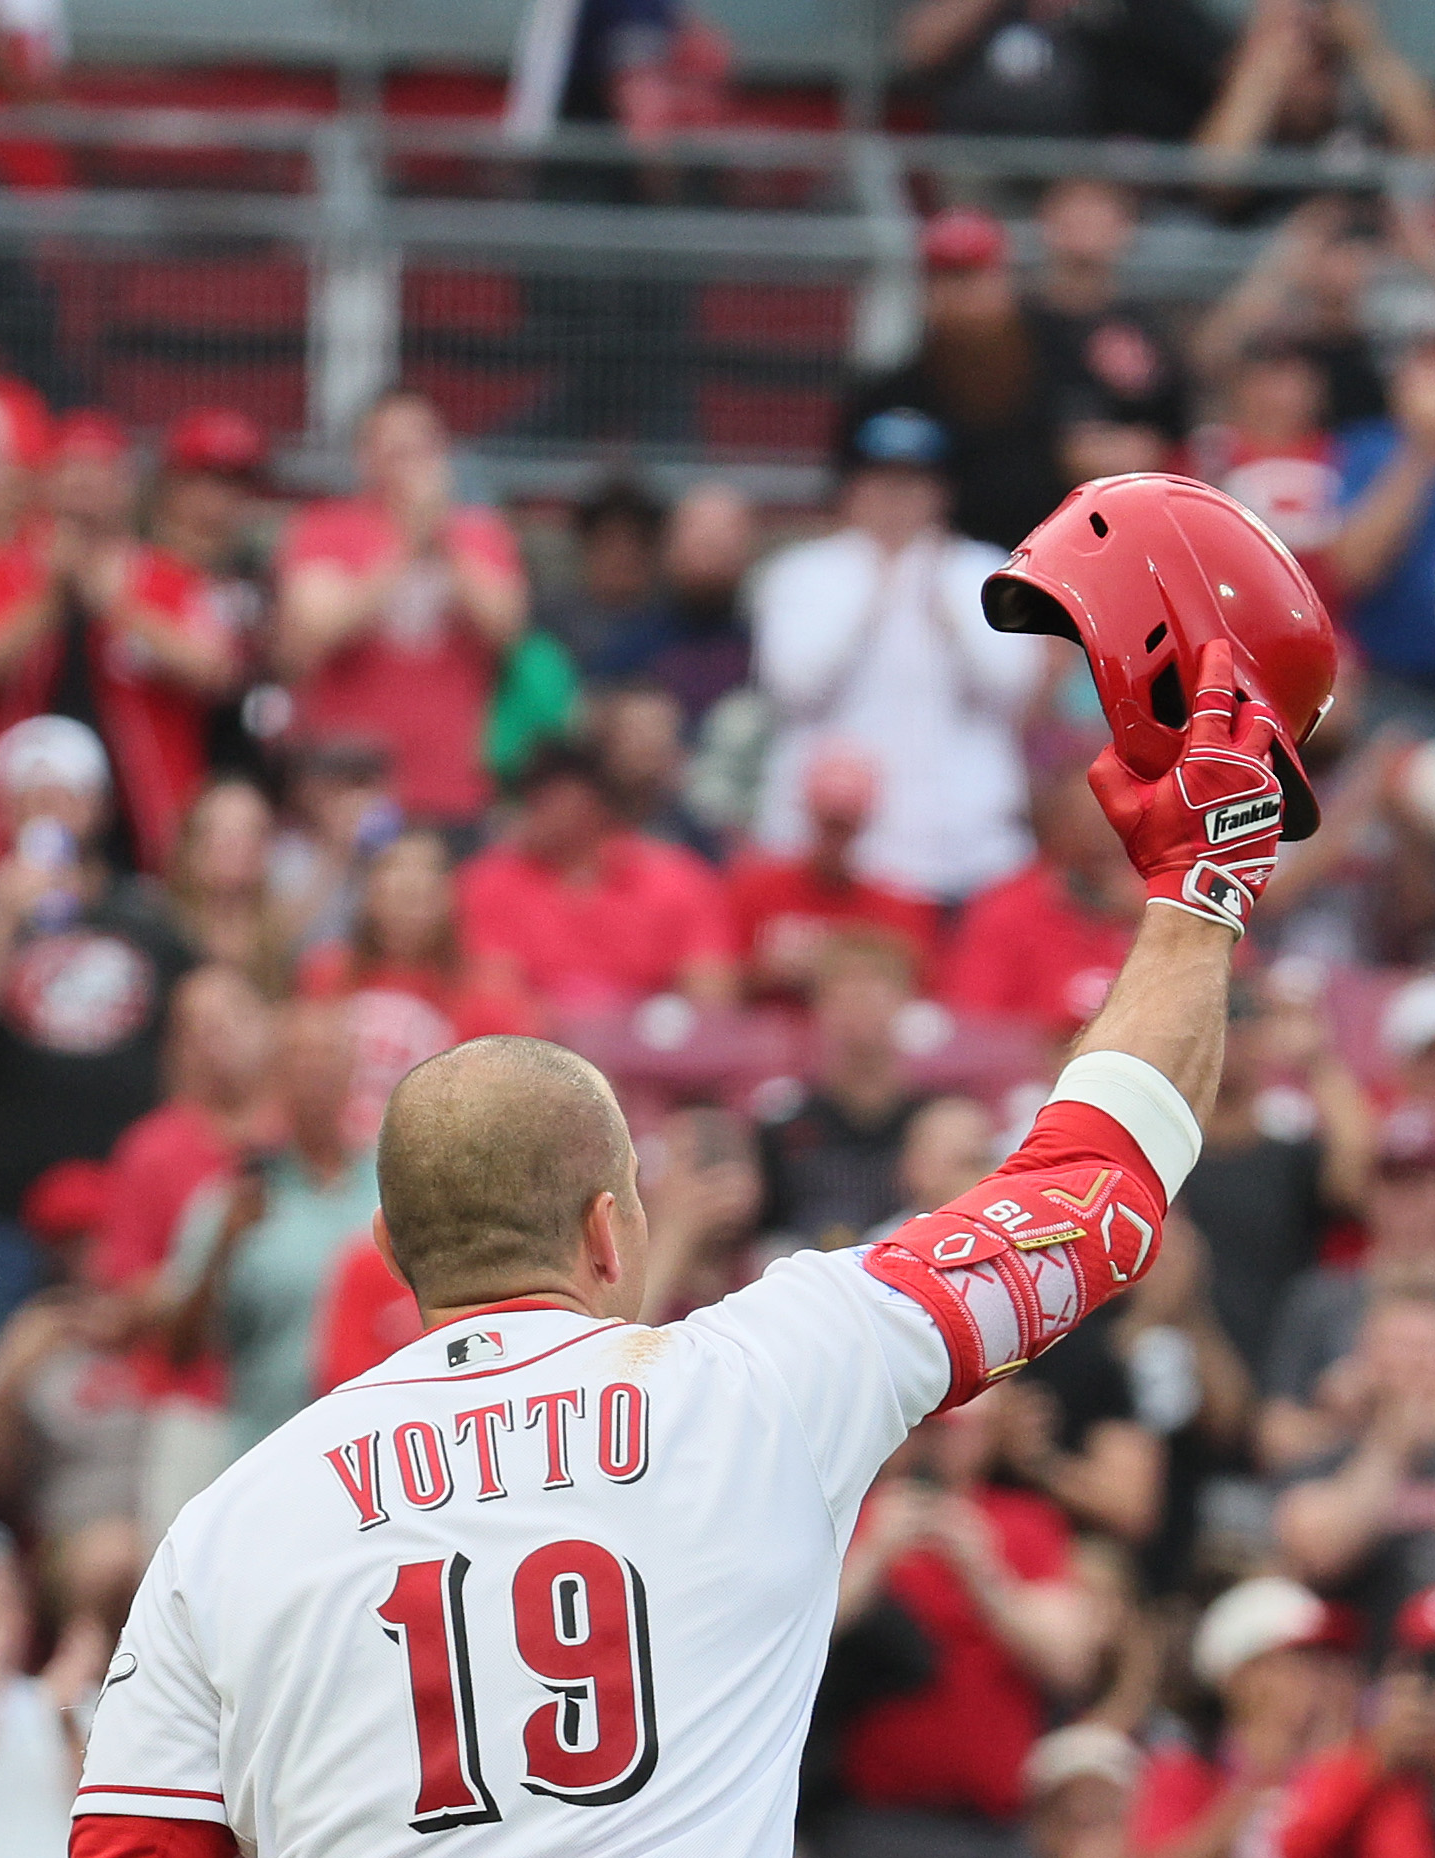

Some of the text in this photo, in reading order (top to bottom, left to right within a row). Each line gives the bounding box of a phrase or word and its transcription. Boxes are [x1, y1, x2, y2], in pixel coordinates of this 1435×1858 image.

[1212, 800, 1280, 841] Franklin
[982, 1199, 1034, 1233] 19
[320, 1382, 649, 1531] VOTTO
[366, 1537, 660, 1835] 19
